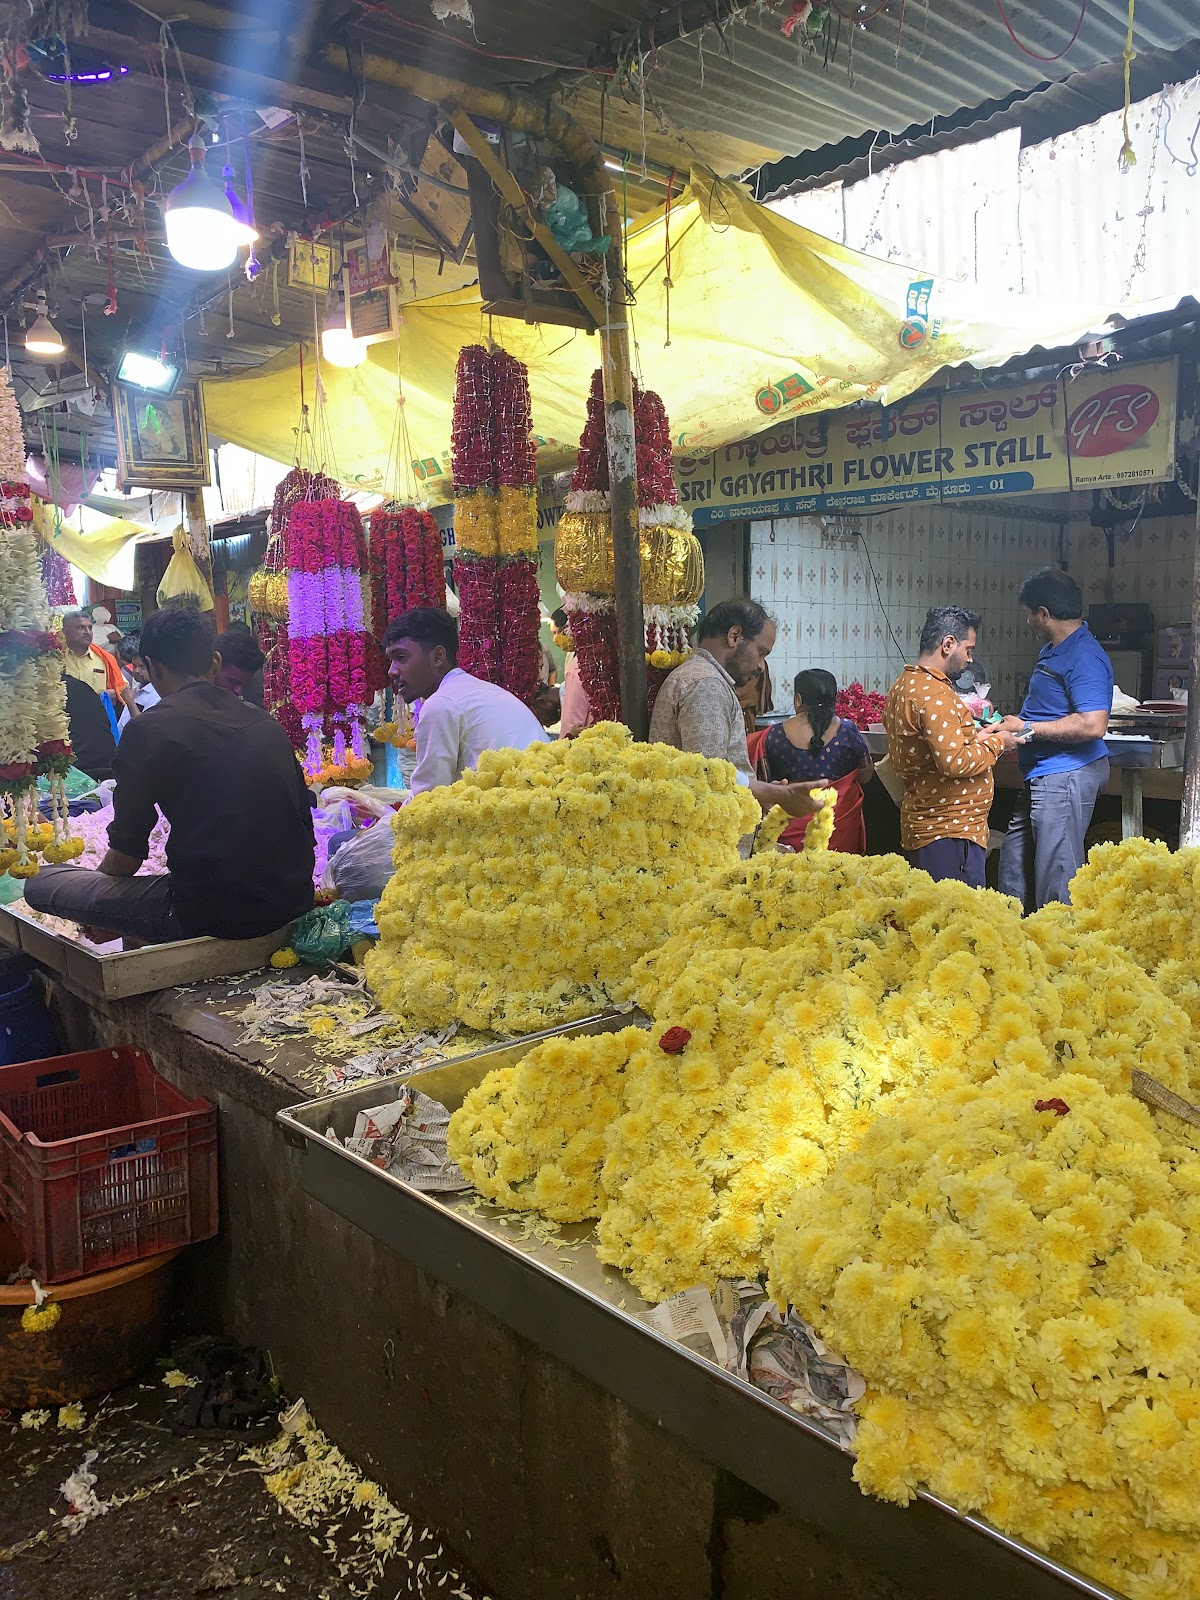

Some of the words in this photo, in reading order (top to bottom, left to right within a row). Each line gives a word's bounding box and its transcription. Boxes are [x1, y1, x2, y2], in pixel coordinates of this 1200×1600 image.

[959, 384, 1058, 432] ಸ್ಟಾಲ್
[1070, 392, 1152, 449] GFS
[680, 479, 712, 502] SRI
[720, 462, 833, 498] GAYATHRI
[844, 447, 955, 485] FLOWER
[964, 434, 1053, 468] STALL
[1075, 475, 1097, 483] Ramya
[1116, 469, 1154, 479] 9972810571
[783, 502, 791, 512] &
[988, 479, 1005, 491] 01
